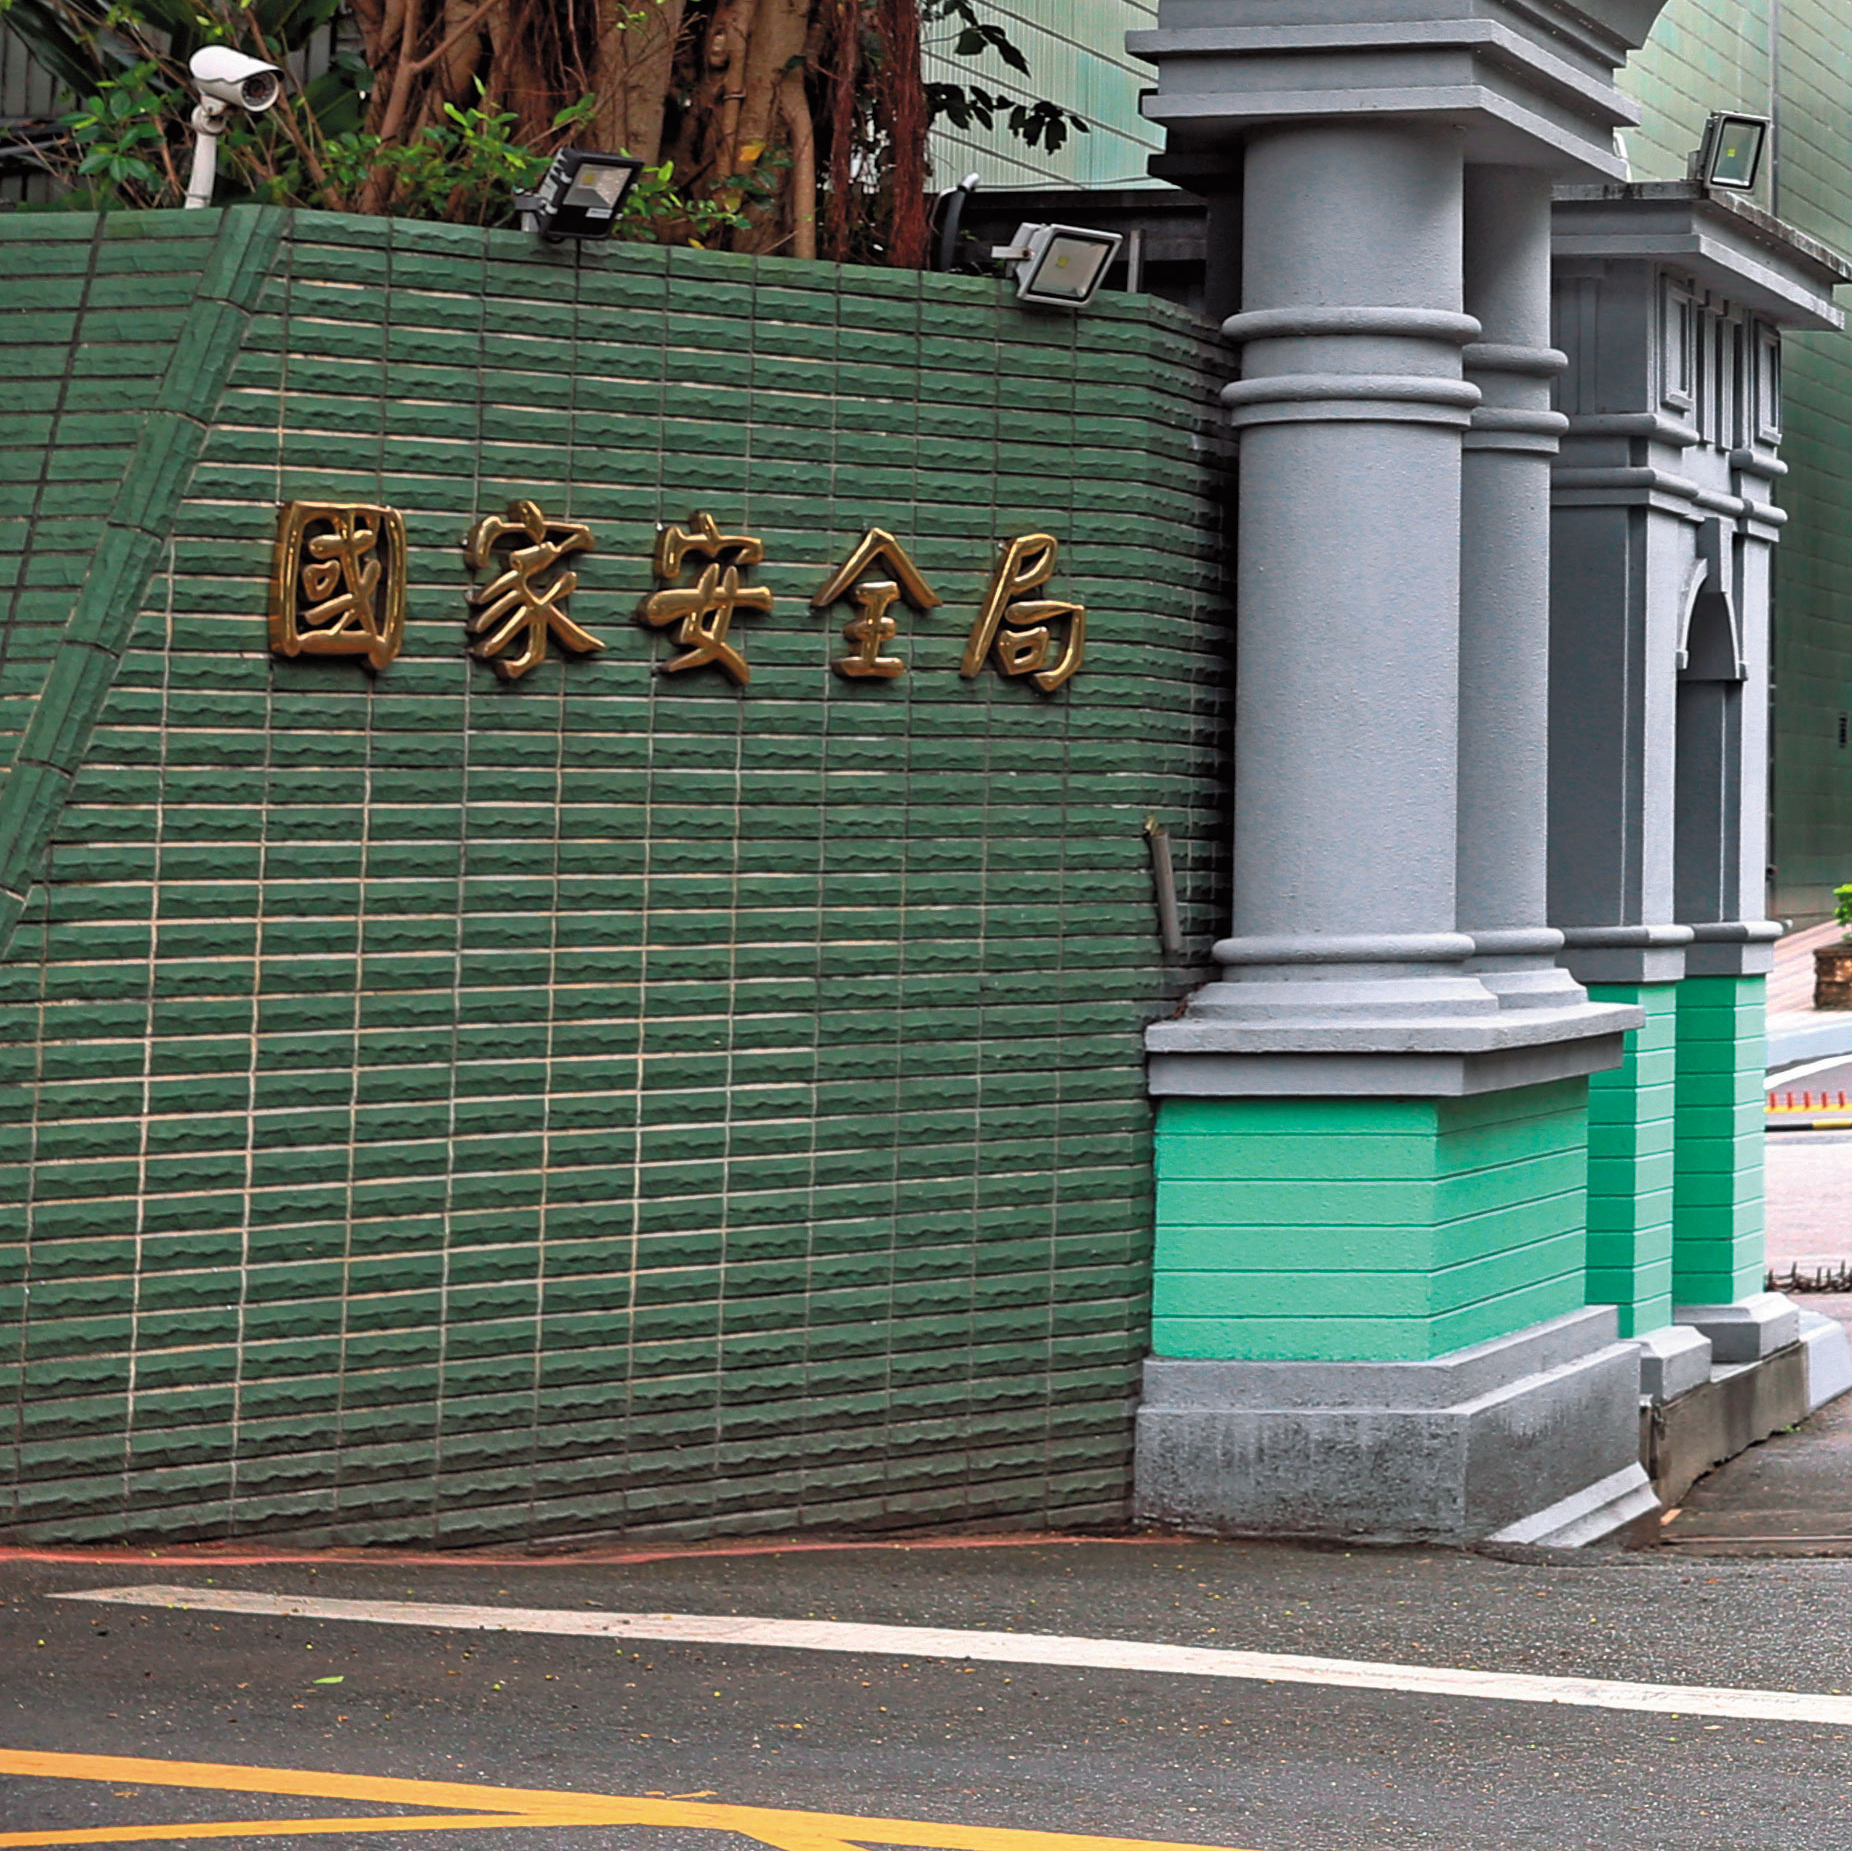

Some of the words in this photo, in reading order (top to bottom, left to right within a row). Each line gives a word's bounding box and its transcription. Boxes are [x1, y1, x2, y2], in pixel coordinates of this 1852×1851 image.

[269, 500, 1086, 692] 國家安全局
